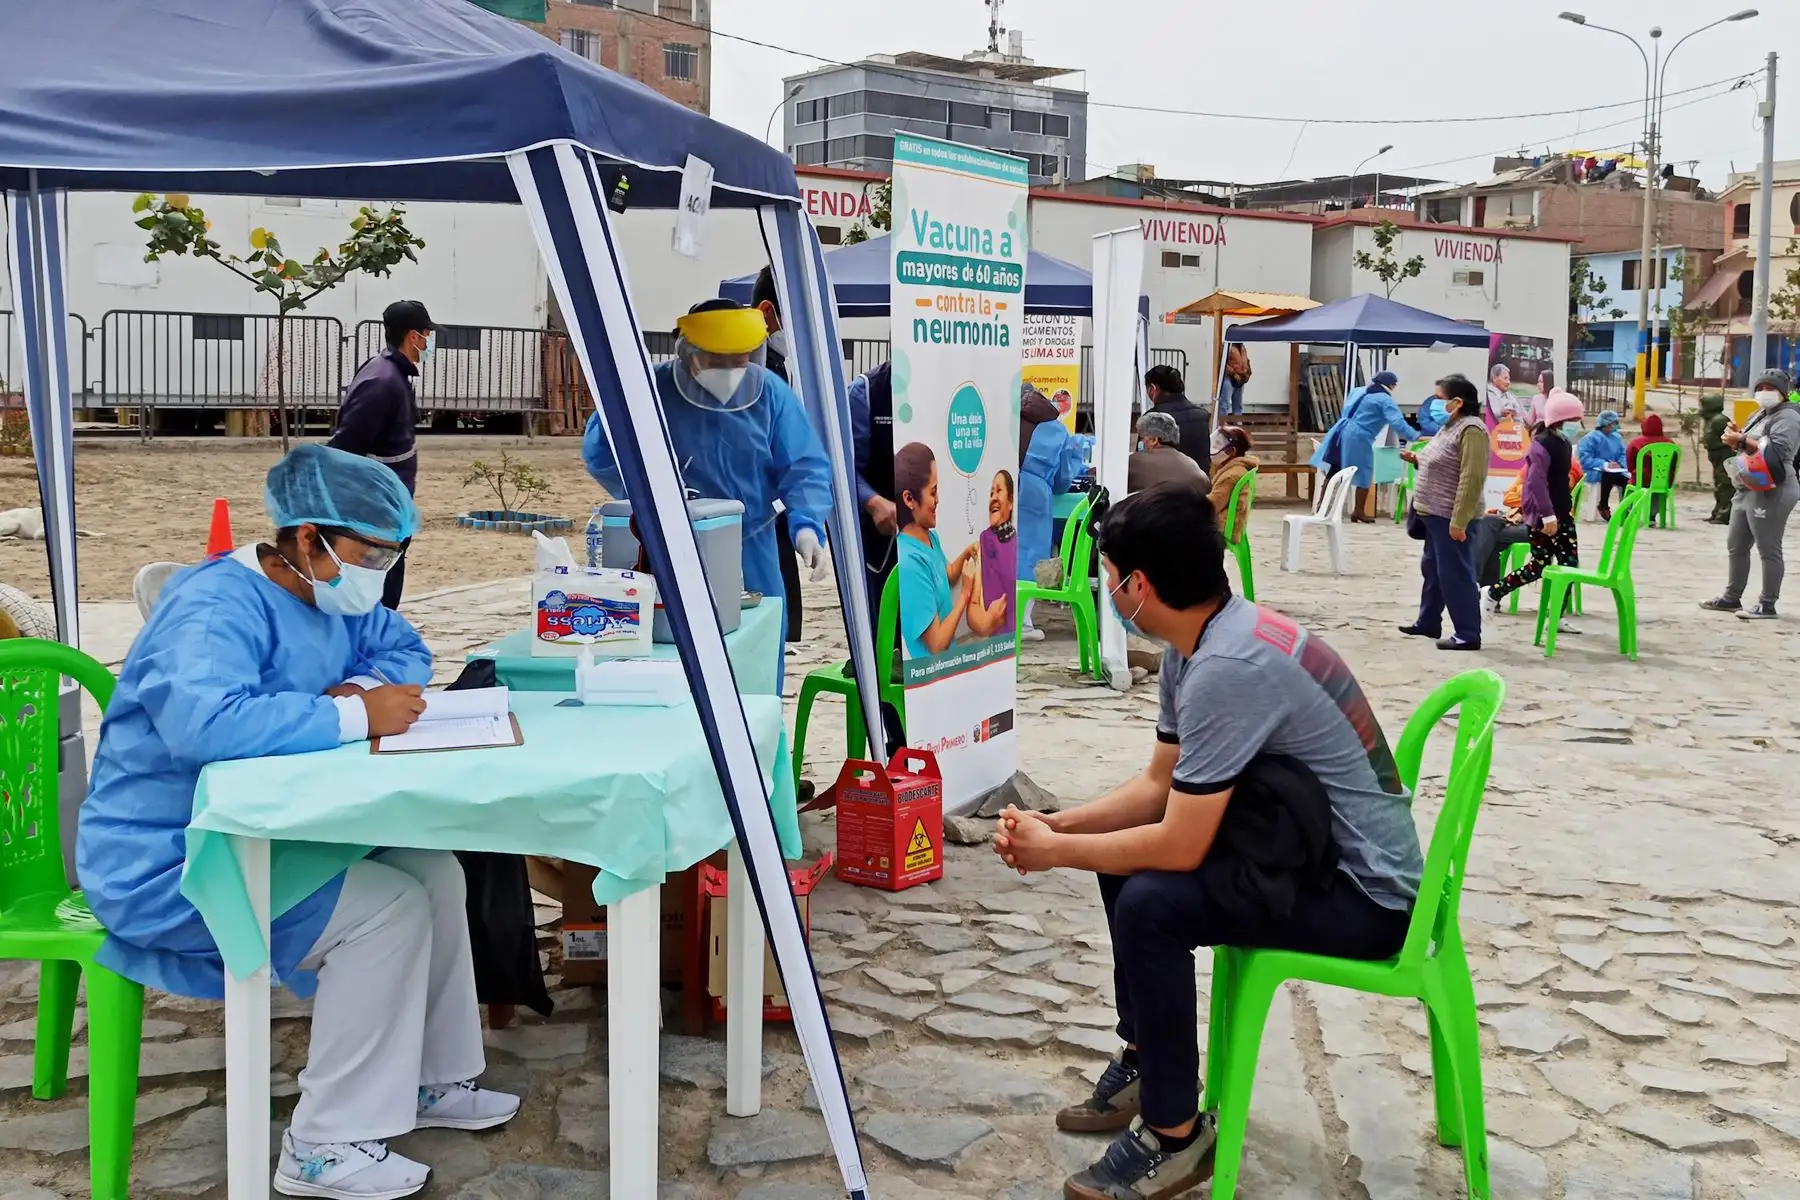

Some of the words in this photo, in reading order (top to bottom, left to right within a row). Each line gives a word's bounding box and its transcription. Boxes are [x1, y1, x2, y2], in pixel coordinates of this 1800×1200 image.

[899, 140, 922, 154] GRATIS
[911, 207, 993, 256] Vacuna
[1000, 231, 1012, 257] a
[1140, 218, 1227, 246] VIVIENDA
[1434, 238, 1503, 264] VIVIENDA
[902, 261, 958, 282] mayores
[962, 263, 974, 282] de
[975, 265, 991, 283] 60
[992, 266, 1020, 287] años
[936, 292, 975, 314] contra
[979, 292, 991, 315] la
[912, 313, 1010, 347] neumonía
[1045, 338, 1075, 346] DROGAS
[1030, 348, 1054, 358] LIMA
[1056, 348, 1075, 358] SUR
[951, 412, 968, 425] Una
[955, 427, 970, 437] una
[952, 439, 963, 449] en
[964, 437, 972, 448] la
[547, 615, 631, 629] Ariess
[910, 668, 926, 678] Para
[897, 784, 939, 803] BIODESCARTE
